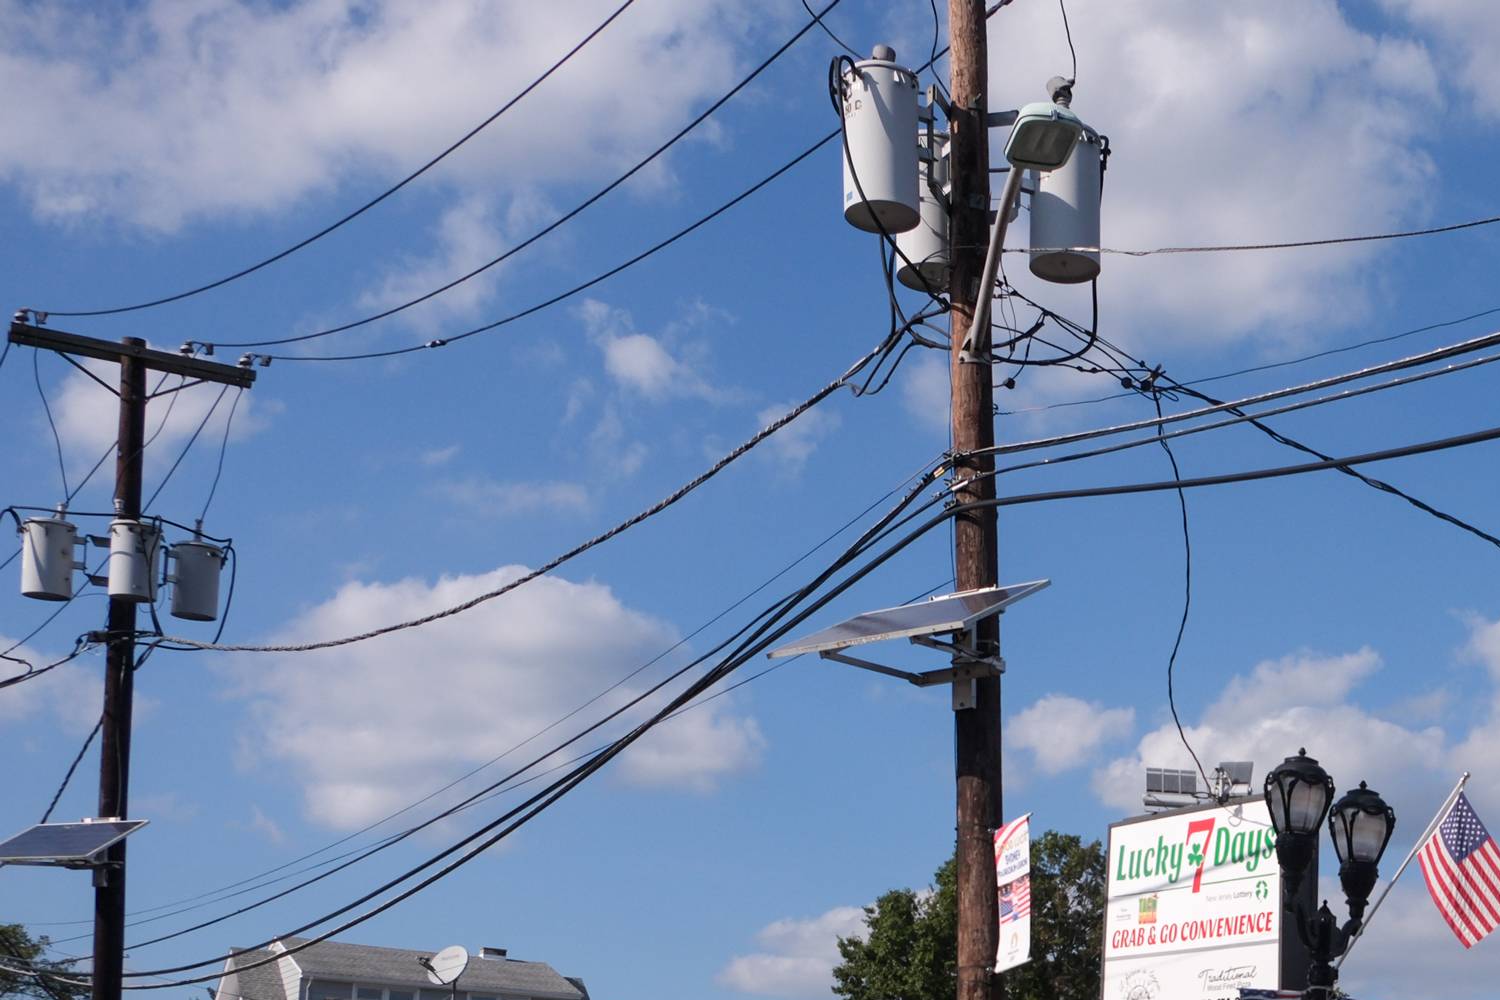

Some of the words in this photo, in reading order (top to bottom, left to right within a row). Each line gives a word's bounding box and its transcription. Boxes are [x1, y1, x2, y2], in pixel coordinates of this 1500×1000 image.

[1116, 835, 1184, 884] Lucky
[1186, 817, 1216, 894] 7
[1213, 826, 1276, 872] Days
[1112, 927, 1145, 949] GRAB
[1147, 926, 1157, 945] &
[1160, 923, 1178, 944] GO
[1180, 911, 1274, 942] CONVENIENCE
[1198, 965, 1257, 991] Traditional
